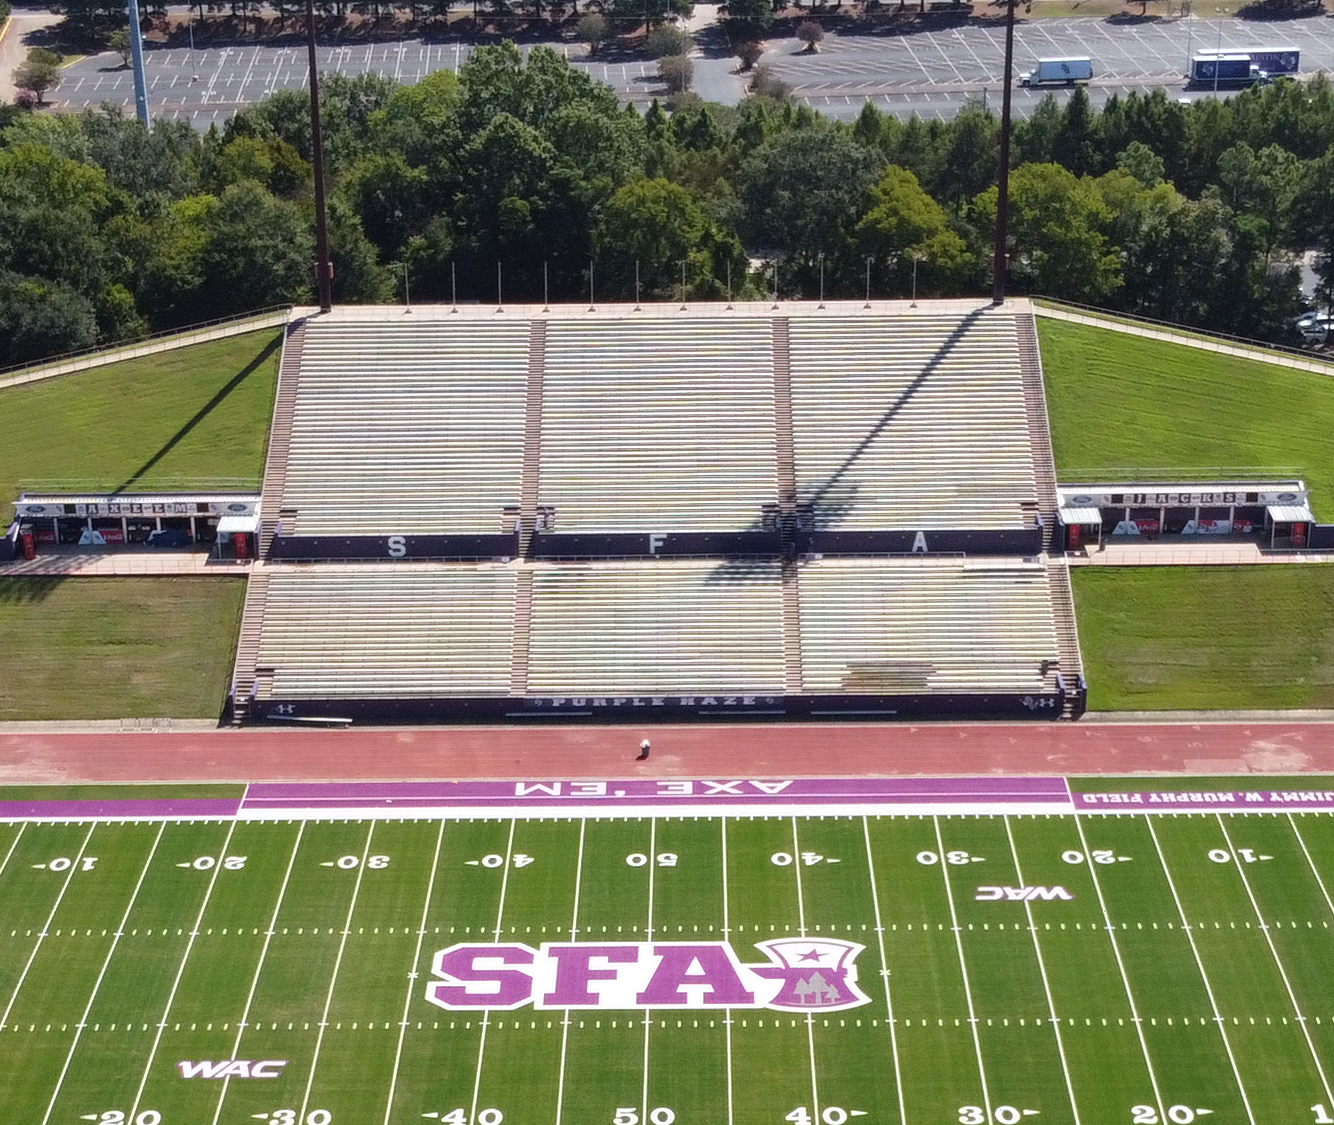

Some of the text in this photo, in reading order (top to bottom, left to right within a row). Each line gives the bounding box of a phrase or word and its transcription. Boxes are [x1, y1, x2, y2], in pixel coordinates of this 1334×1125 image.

[388, 532, 928, 557] S F A
[552, 696, 756, 707] PURPLE HAZE
[657, 780, 794, 795] AXE
[1082, 793, 1144, 804] FIELD
[1149, 792, 1236, 803] MURPHY
[194, 856, 247, 870] 20
[338, 855, 390, 869] 30
[482, 854, 534, 868] 40
[626, 853, 678, 867] 50
[771, 852, 823, 866] 40
[917, 851, 969, 865] 30
[1062, 850, 1115, 864] 20
[1208, 849, 1257, 863] 10
[50, 857, 98, 871] 10
[975, 886, 1073, 900] WAC
[424, 942, 767, 1011] SFA
[179, 1059, 288, 1078] WAC
[613, 1107, 676, 1125] 50
[786, 1107, 848, 1125] 40
[959, 1106, 1021, 1125] 30
[1131, 1105, 1195, 1124] 20
